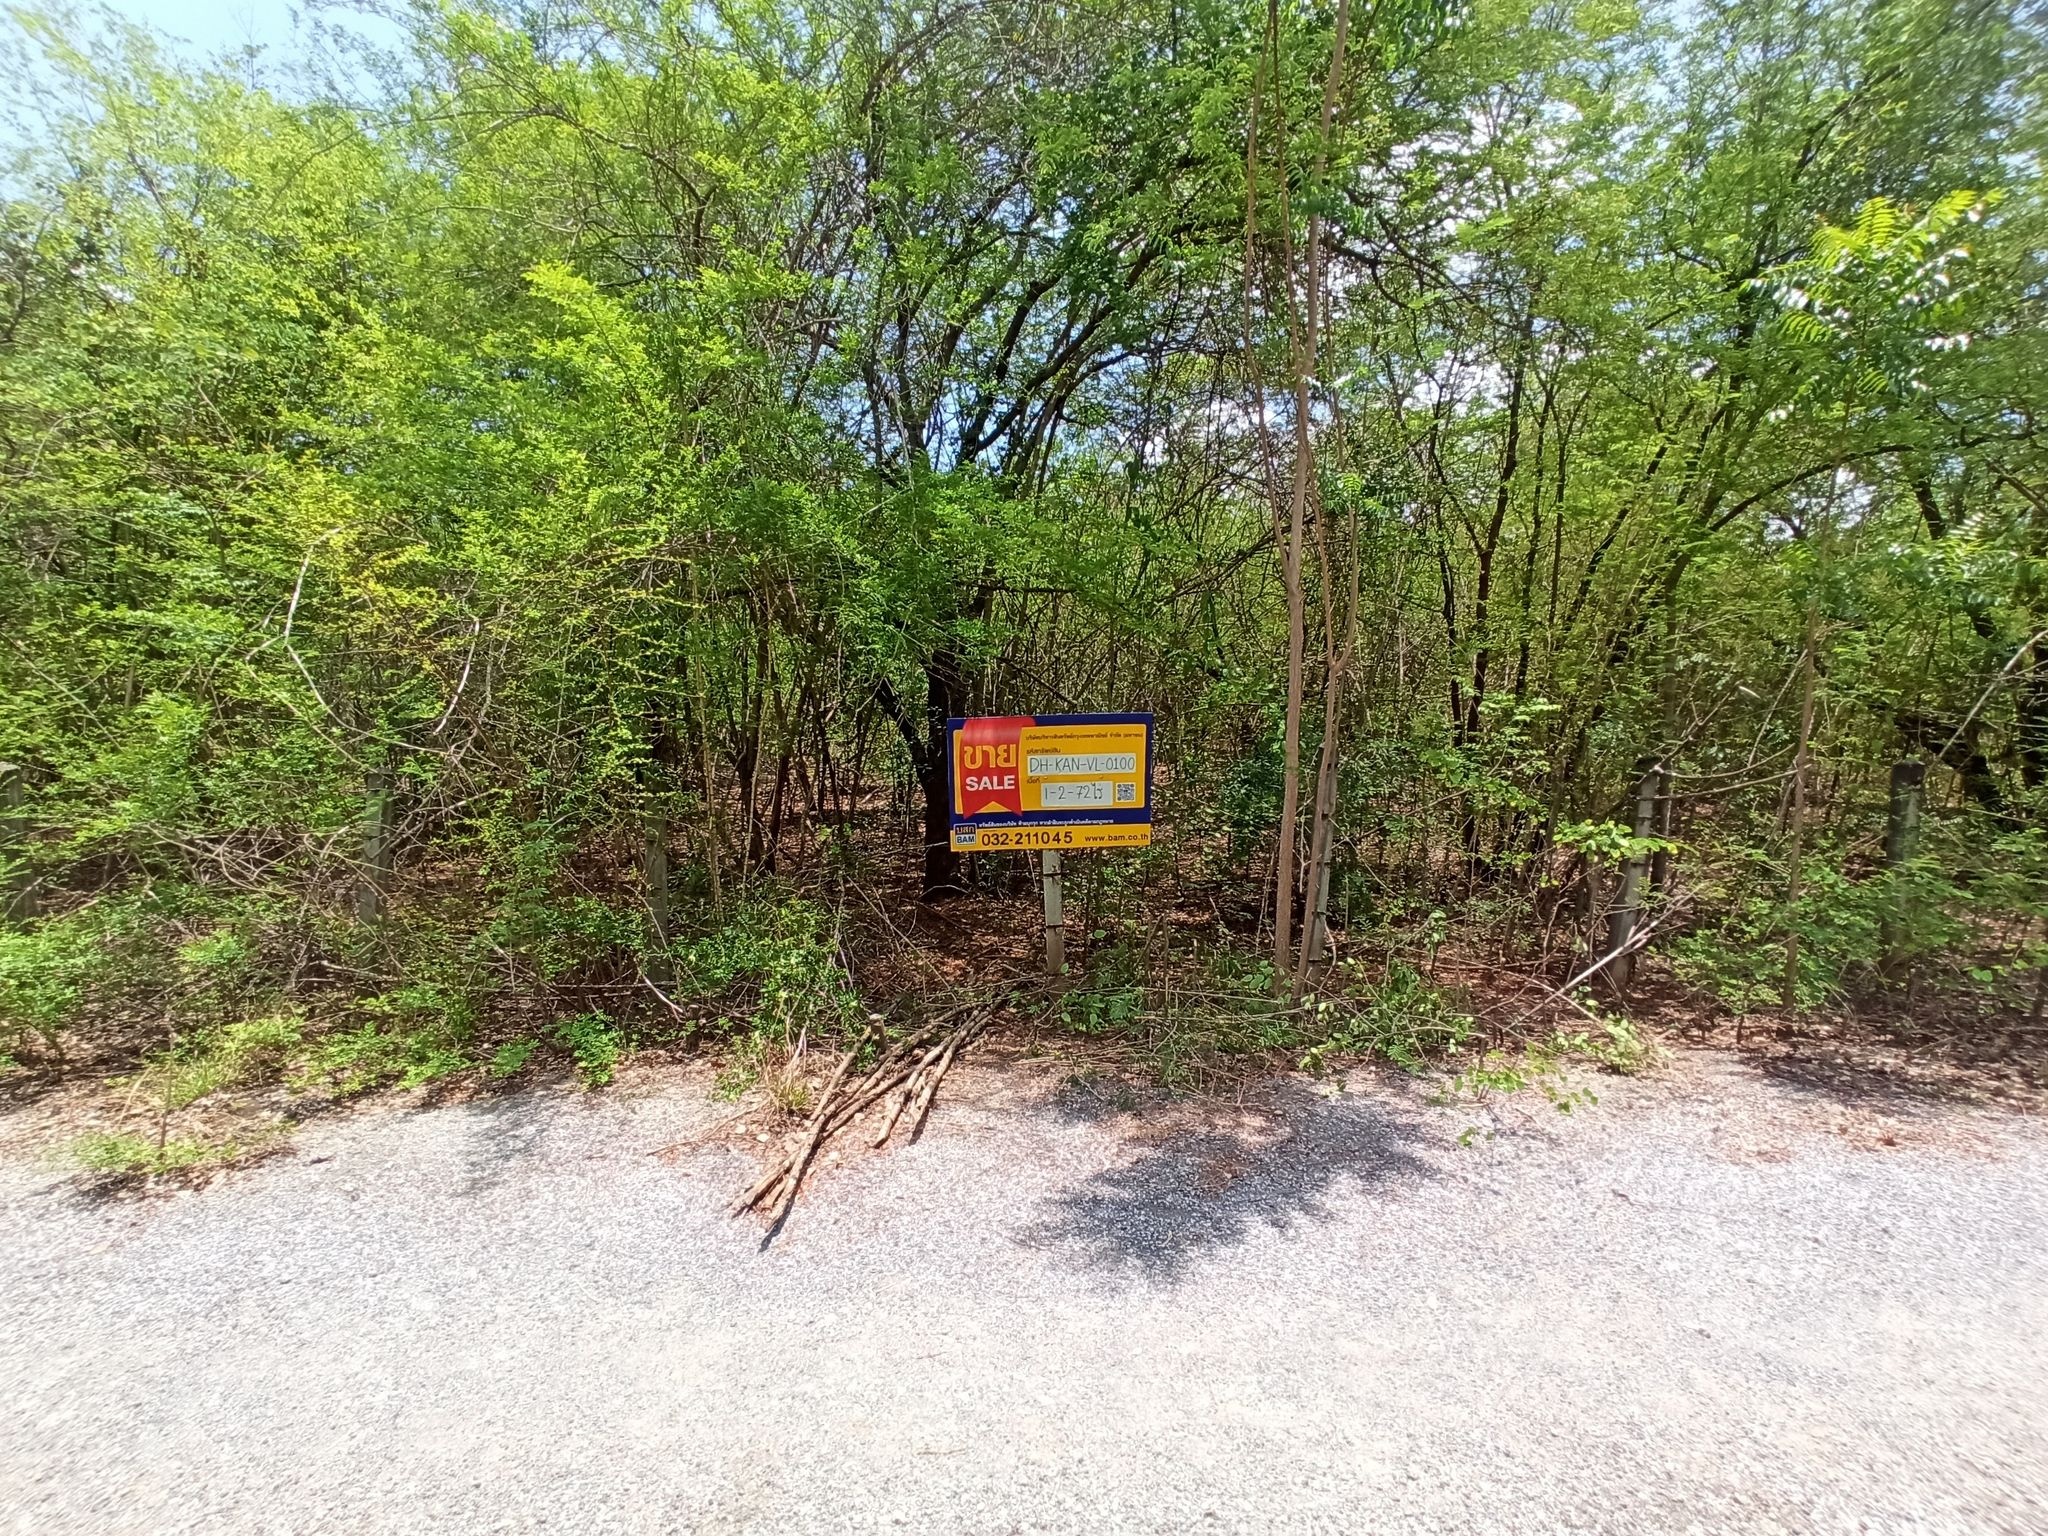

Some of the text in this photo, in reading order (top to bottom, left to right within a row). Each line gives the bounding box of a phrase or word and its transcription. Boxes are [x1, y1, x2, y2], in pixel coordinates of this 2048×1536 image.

[964, 744, 1016, 769] ขาย
[1029, 757, 1135, 773] DH-KAN-VL-0100
[965, 775, 1016, 791] SALE
[956, 836, 975, 844] BAM
[981, 831, 1073, 846] 032-211045
[1084, 833, 1149, 842] www.bam.co.th
